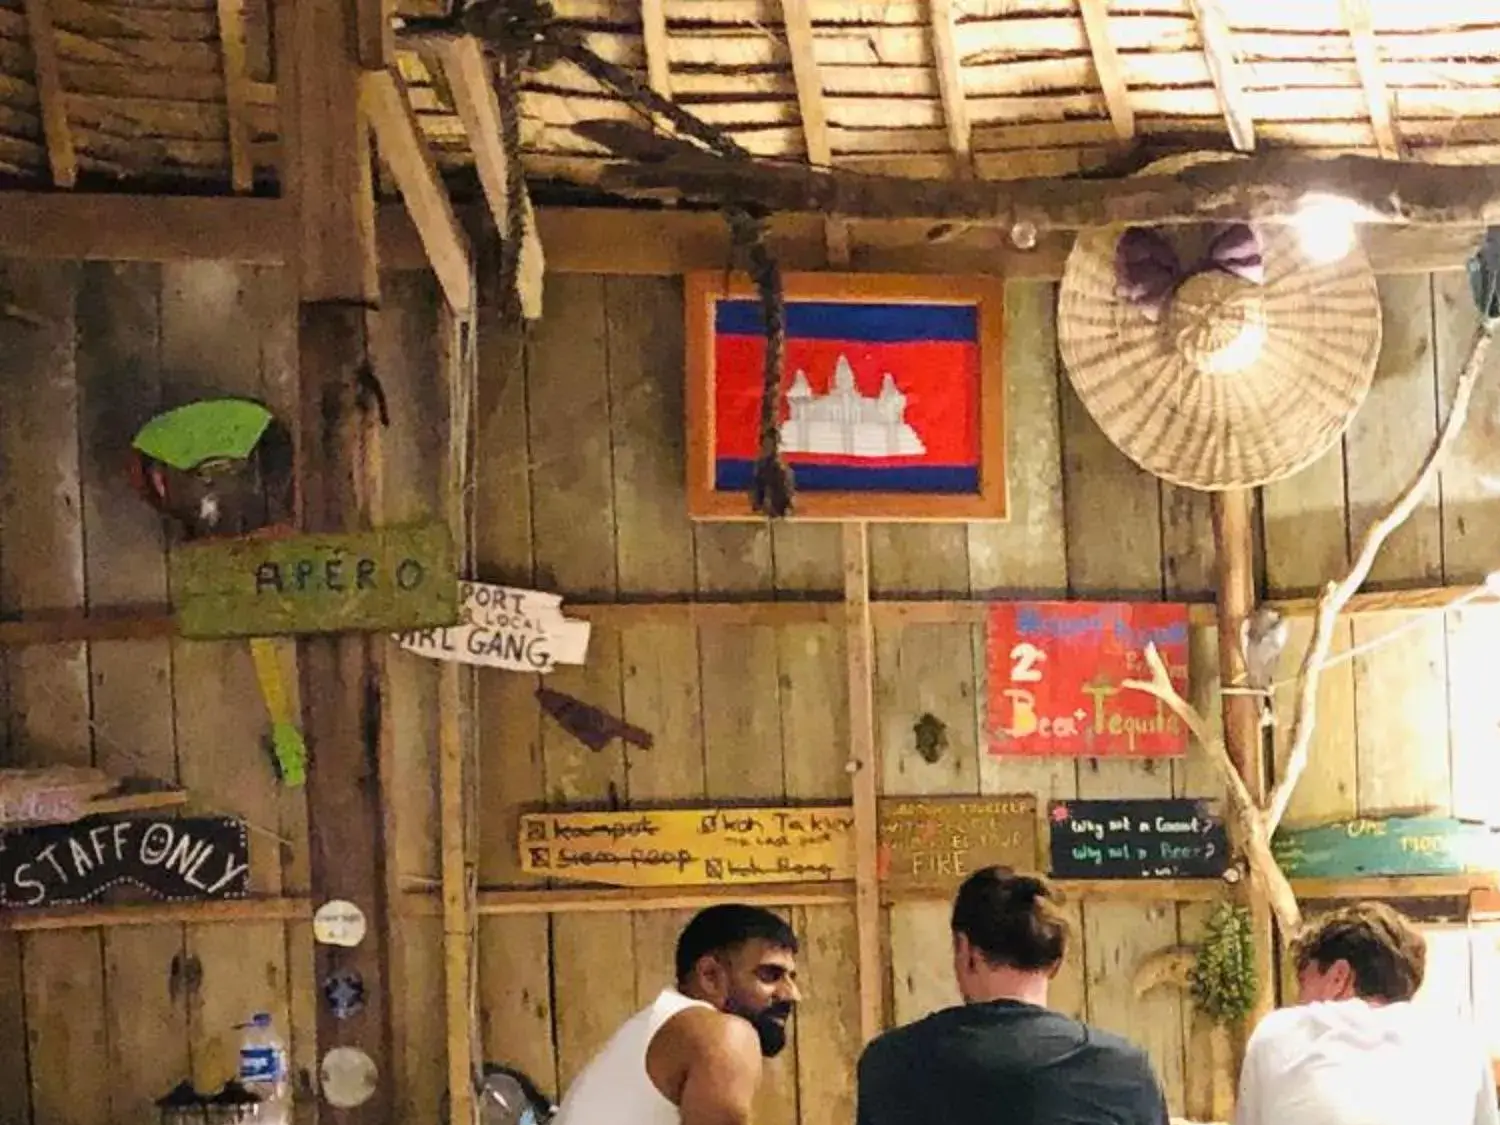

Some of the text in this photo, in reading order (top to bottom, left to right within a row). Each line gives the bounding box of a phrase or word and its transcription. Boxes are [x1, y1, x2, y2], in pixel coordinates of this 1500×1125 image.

[485, 614, 546, 634] LOCAL
[467, 627, 550, 668] GANG
[1009, 643, 1048, 682] 2
[14, 821, 249, 905] STAFF ONLY
[912, 851, 970, 876] FIRE
